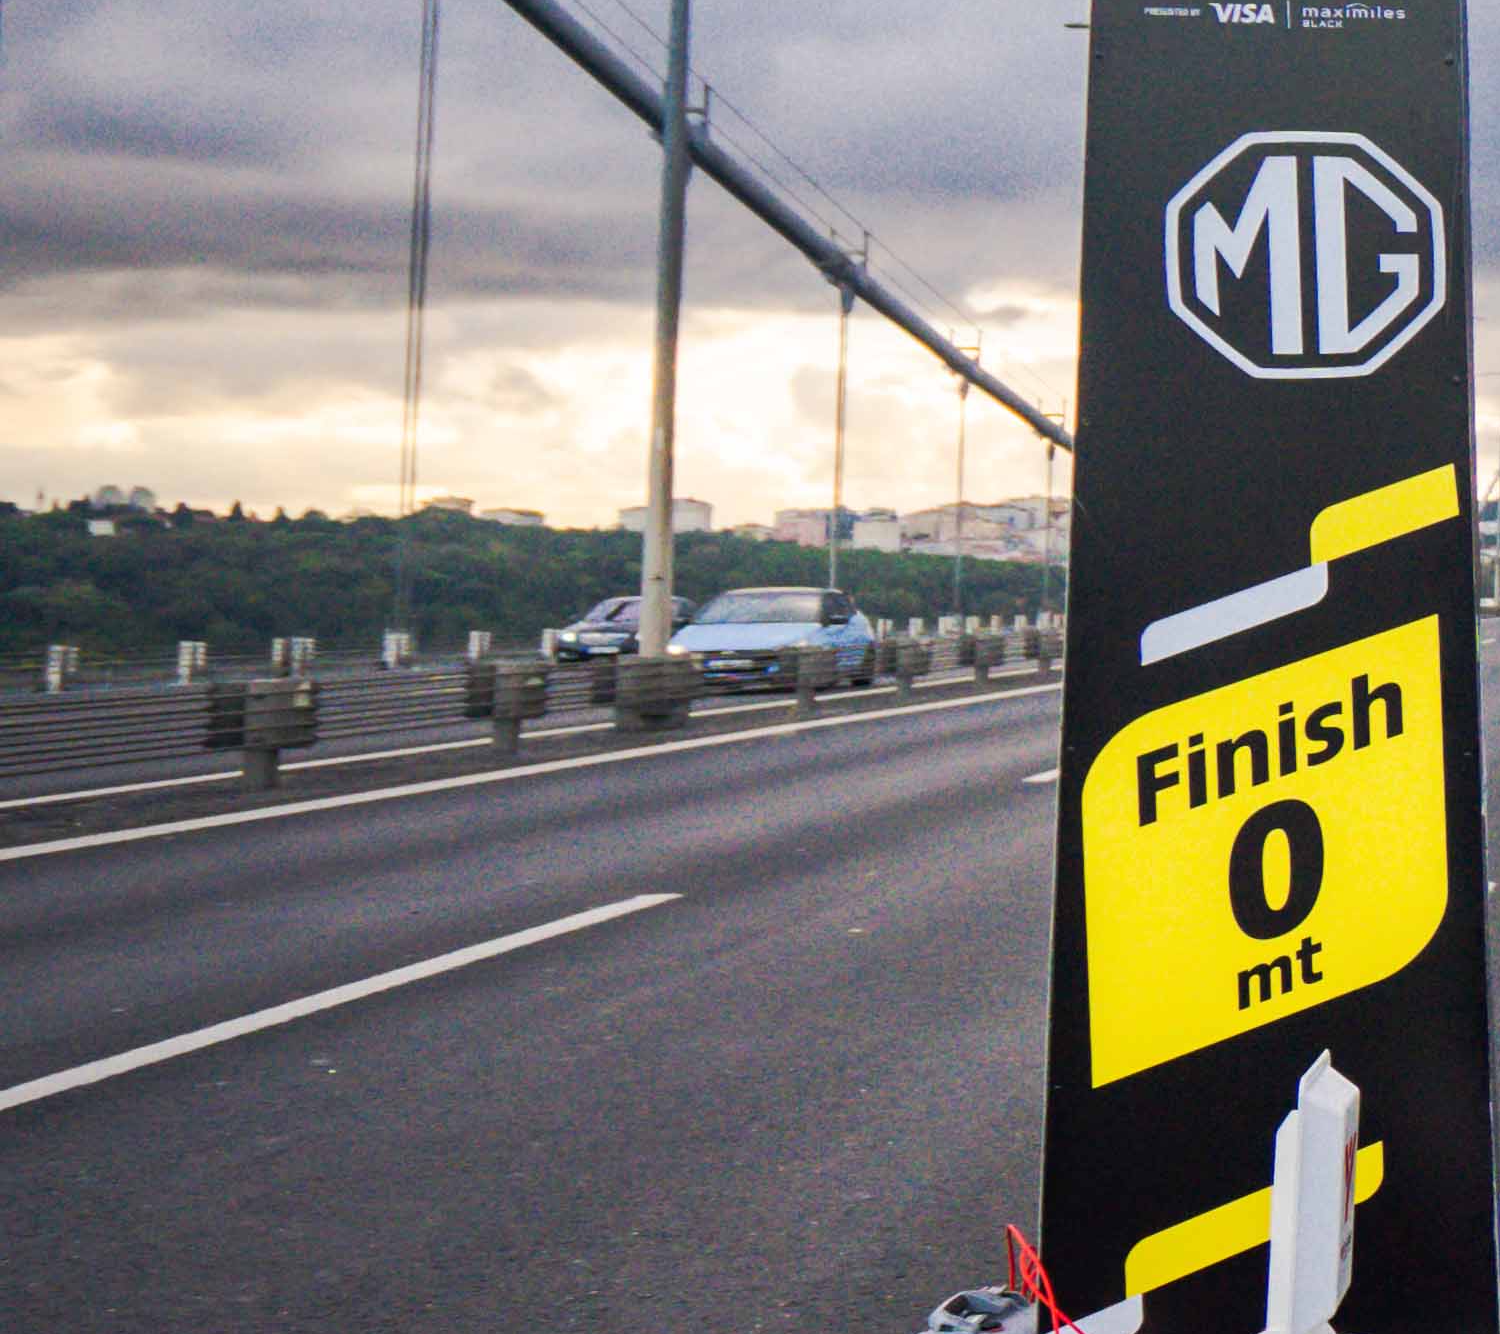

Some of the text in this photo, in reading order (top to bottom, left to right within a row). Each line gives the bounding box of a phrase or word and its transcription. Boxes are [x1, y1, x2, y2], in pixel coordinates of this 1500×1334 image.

[1208, 2, 1406, 24] VISA maximiles
[1302, 19, 1344, 29] BLACK
[1193, 154, 1420, 355] MG
[1136, 673, 1404, 827] Finish
[1228, 798, 1325, 941] 0
[1237, 936, 1323, 1010] mt
